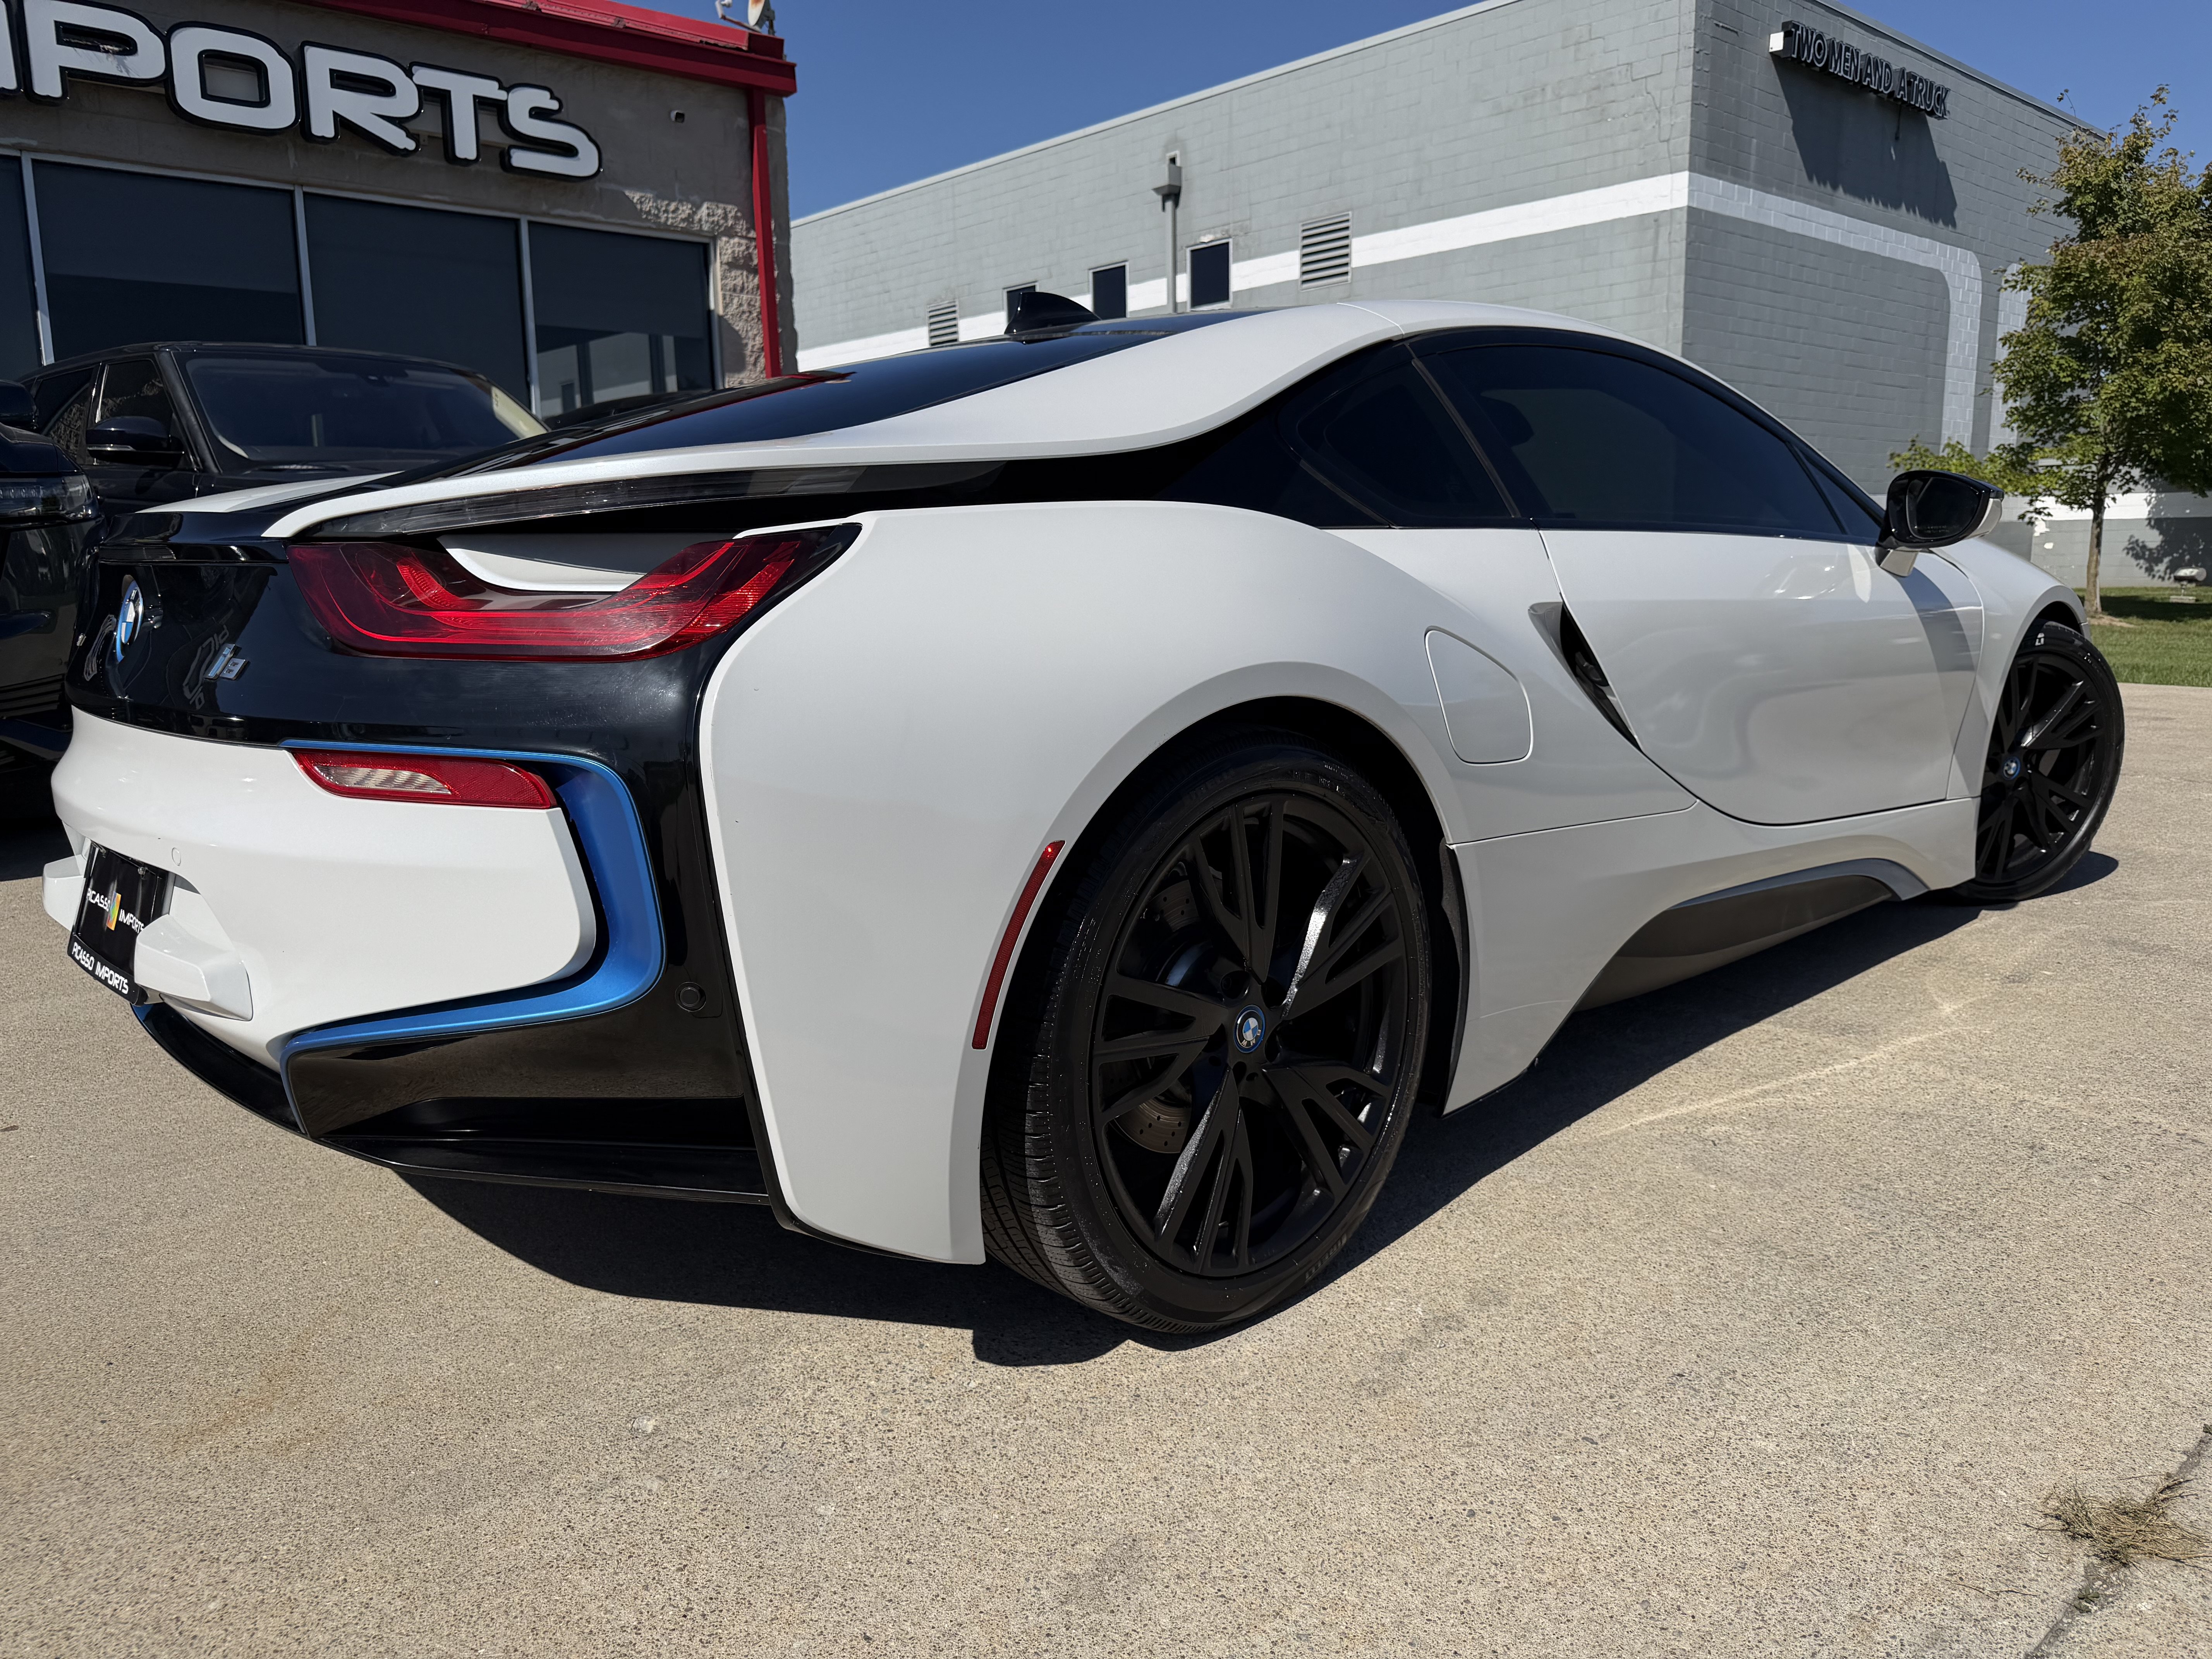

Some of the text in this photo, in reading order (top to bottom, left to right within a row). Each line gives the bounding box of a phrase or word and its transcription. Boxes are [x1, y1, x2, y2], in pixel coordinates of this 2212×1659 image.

[0, 0, 599, 177] PORTS
[1791, 21, 1951, 117] TWO MEN AND A TRUCK
[72, 942, 129, 994] PICASSO IMPORTS
